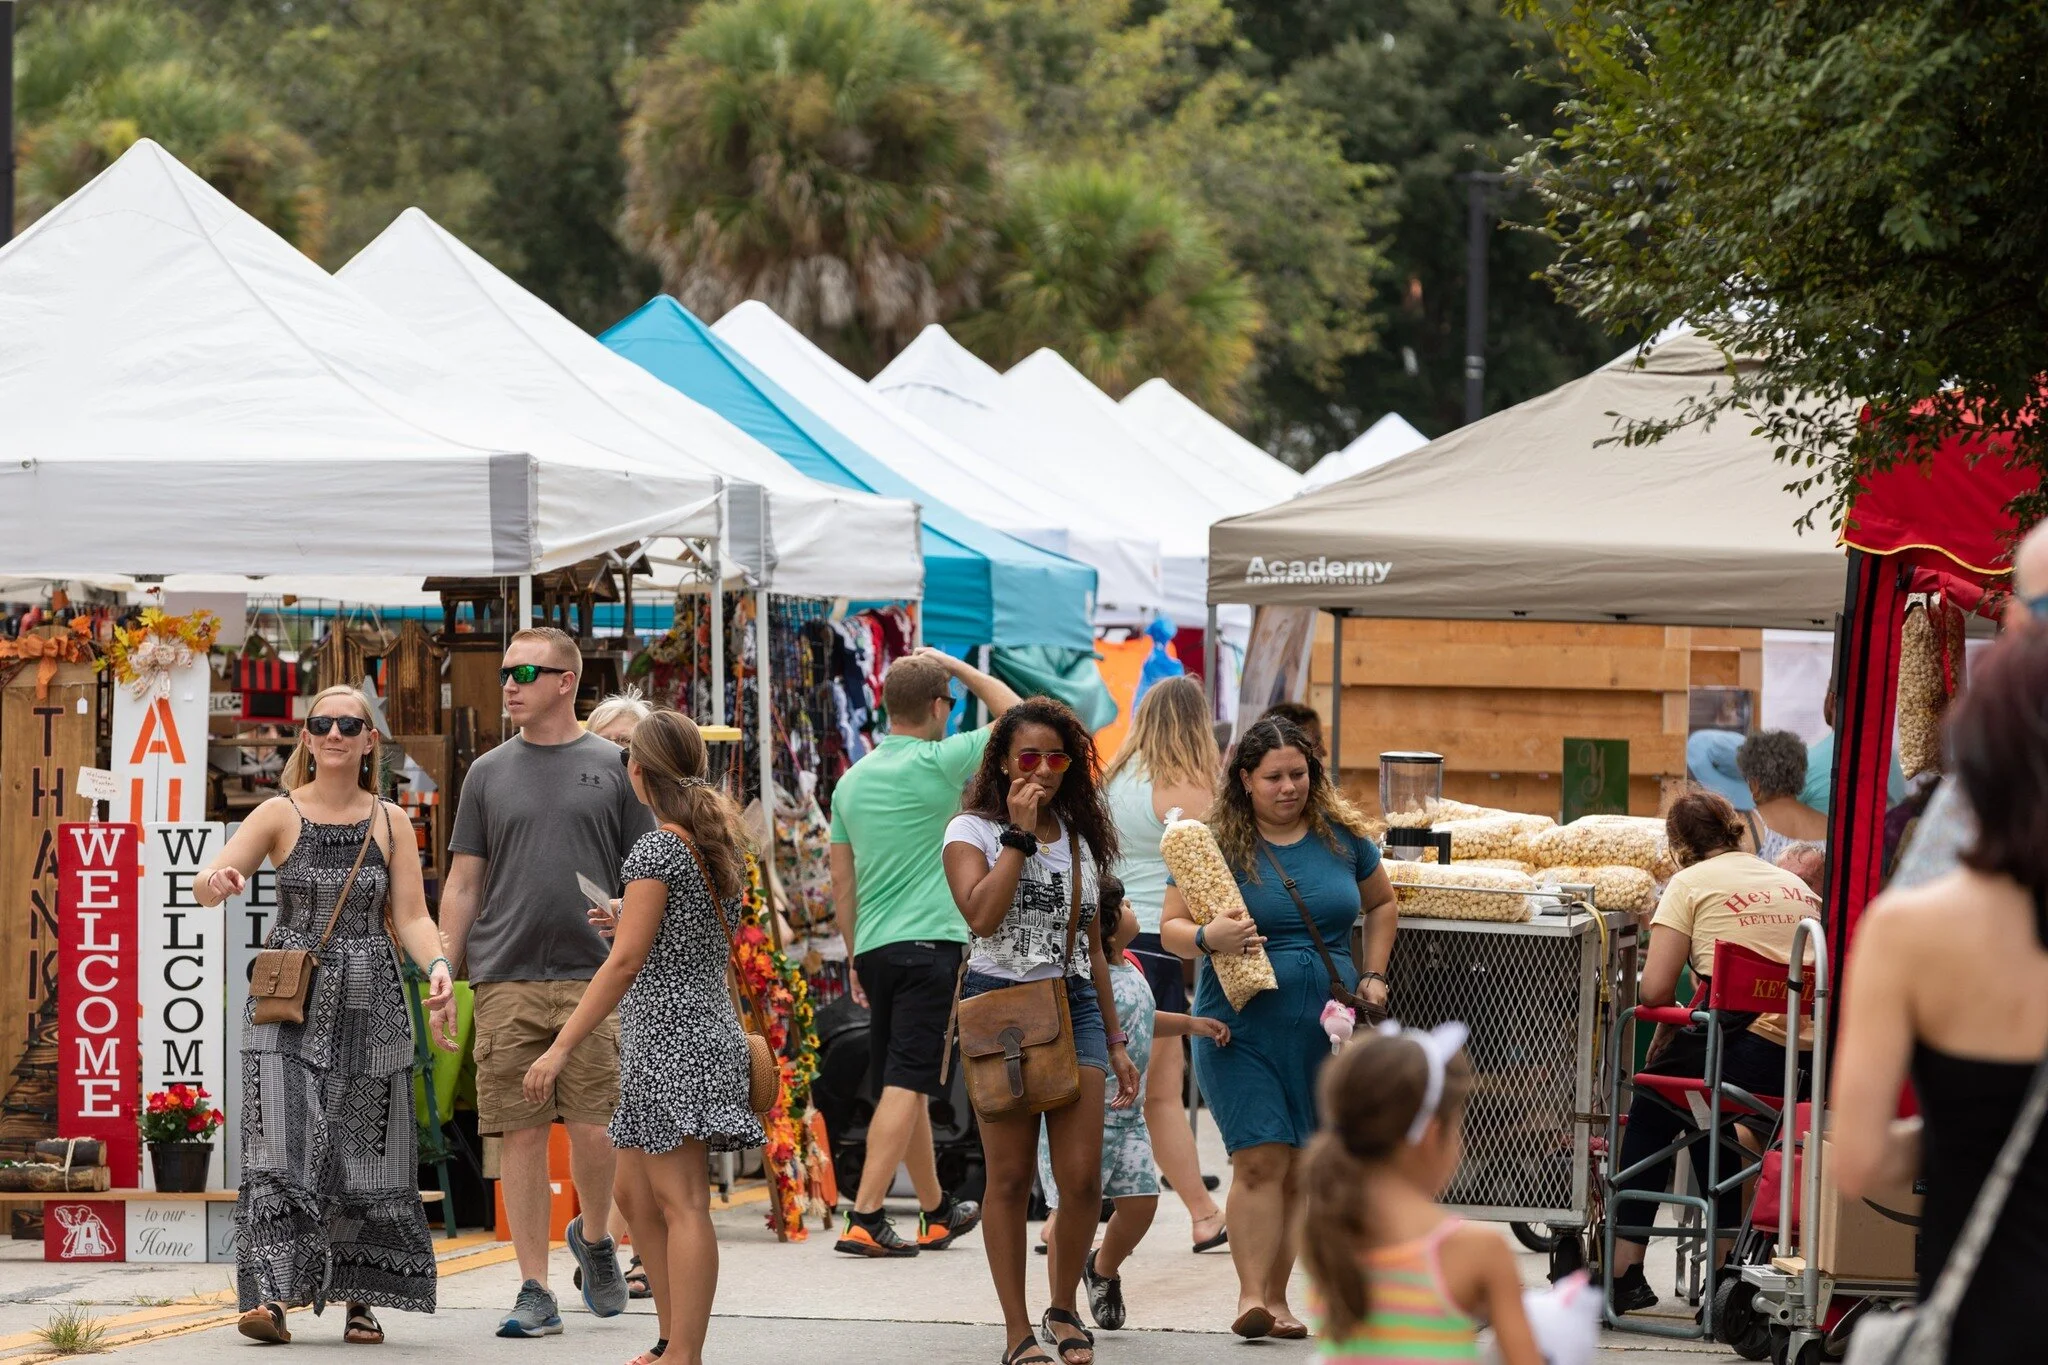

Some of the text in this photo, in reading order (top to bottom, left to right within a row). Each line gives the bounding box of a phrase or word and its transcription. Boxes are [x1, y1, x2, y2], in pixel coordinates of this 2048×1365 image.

[1246, 556, 1393, 583] Academy
[1723, 890, 1771, 914] Hey
[1740, 914, 1796, 927] KETTLE
[70, 828, 125, 1118] WELCOME
[157, 829, 211, 1090] WELCOM
[144, 1207, 186, 1222] to our
[135, 1226, 194, 1257] Home
